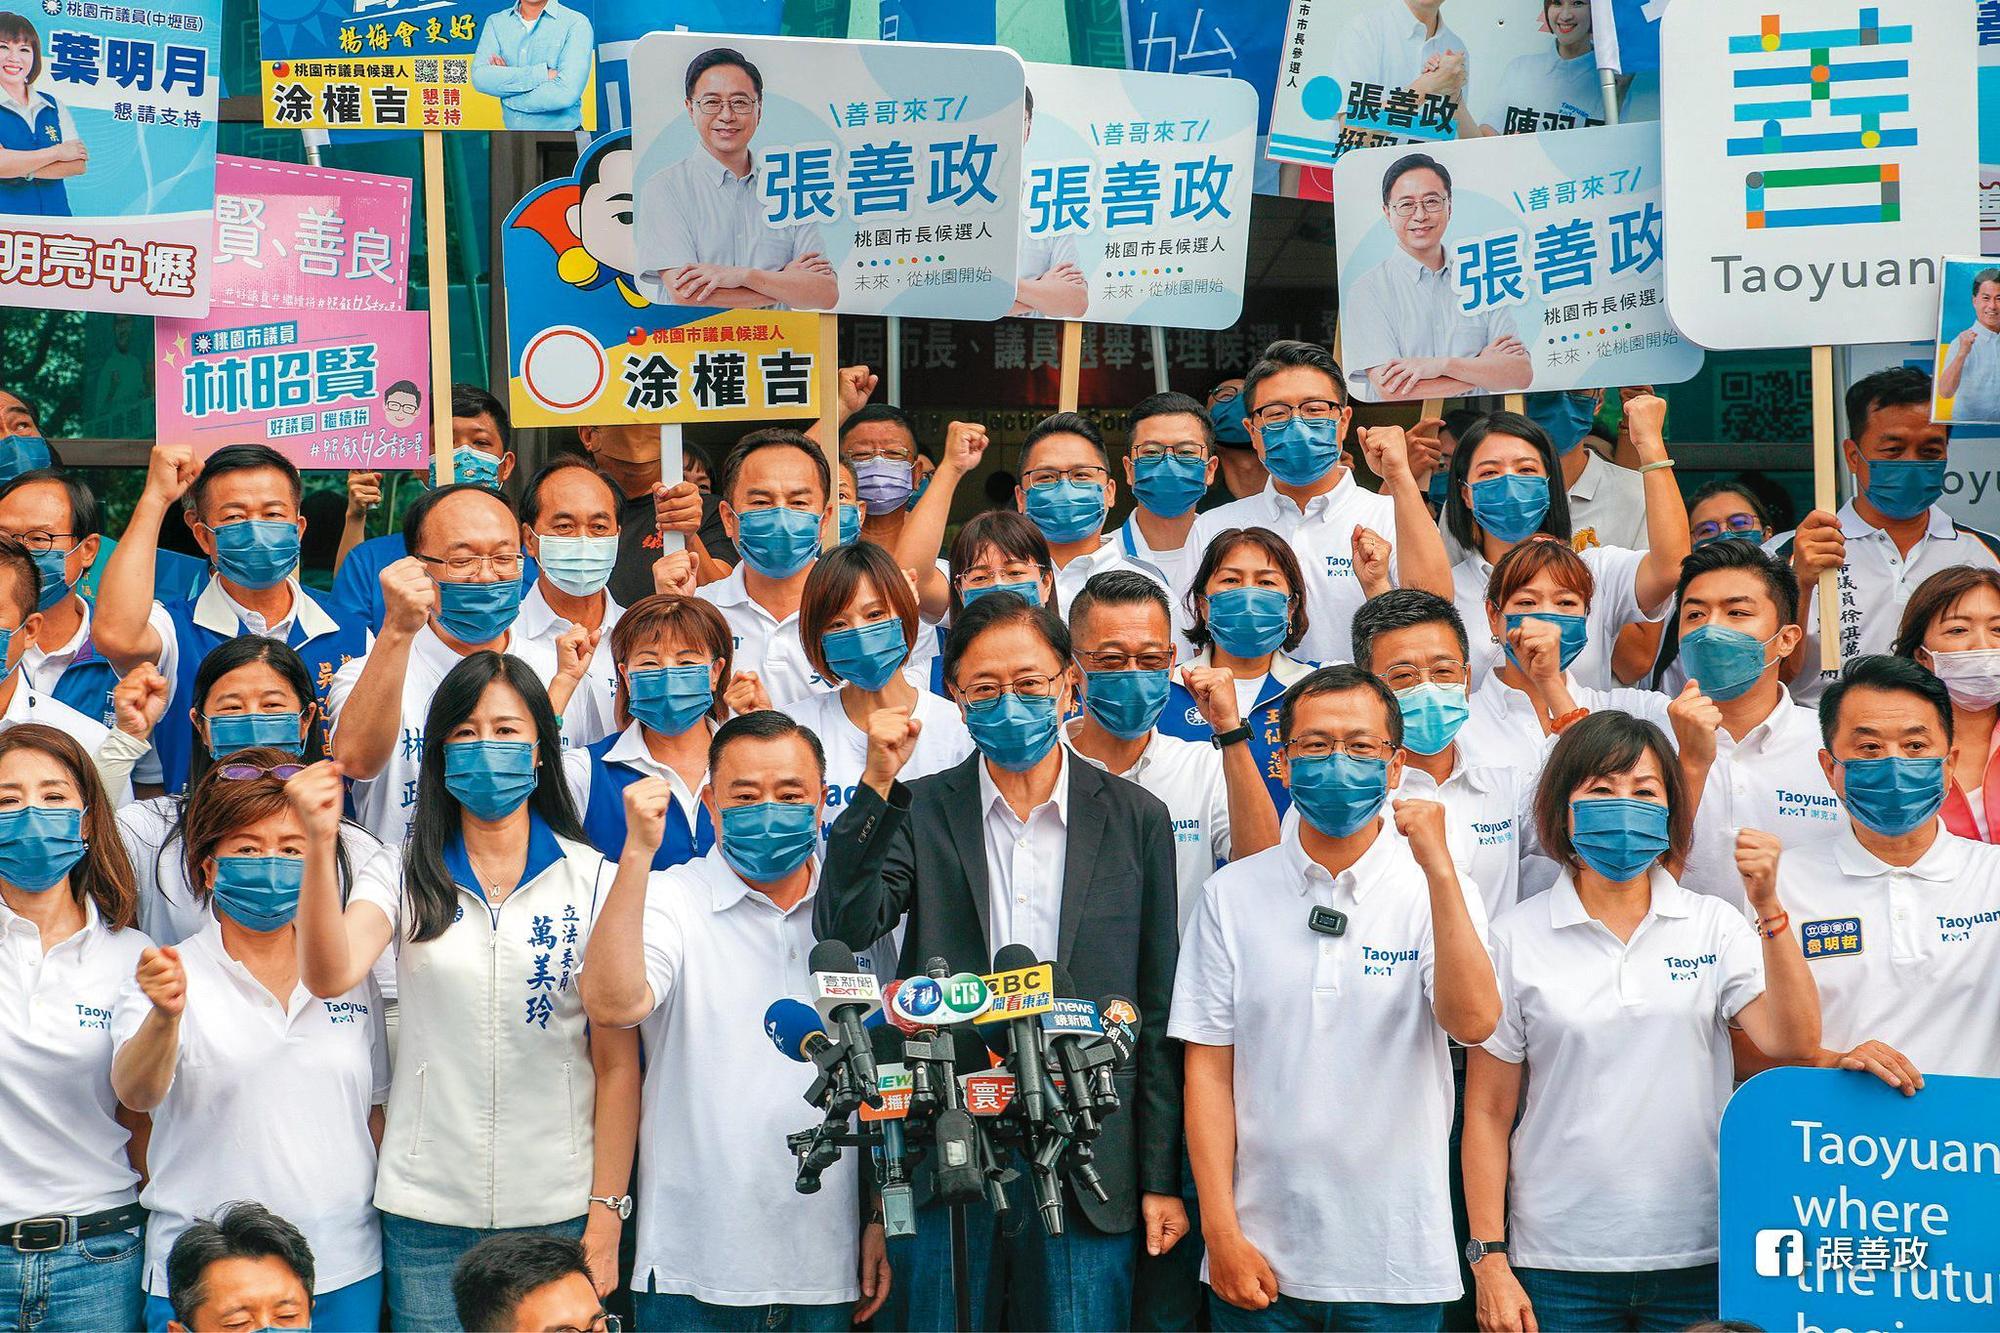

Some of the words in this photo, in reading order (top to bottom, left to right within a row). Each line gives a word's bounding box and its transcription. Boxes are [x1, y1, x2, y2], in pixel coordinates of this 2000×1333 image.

[67, 1, 204, 32] 桃園市議員(中壢區)
[338, 14, 477, 55] 楊梅會更好
[50, 31, 207, 97] 葉明月
[1287, 0, 1312, 88] 市市長參選人
[294, 62, 409, 79] 桃園市議員候選人
[114, 102, 202, 128] 懇請支持
[274, 84, 410, 124] 涂權吉
[422, 88, 461, 107] 懇請
[422, 107, 461, 126] 支持
[1346, 81, 1459, 134] 張善政
[765, 134, 998, 223] 張善政
[1030, 155, 1234, 234] 張善政
[854, 221, 993, 248] 桃園市長候選人
[1105, 236, 1225, 259] 桃園市長候選人
[0, 231, 196, 297] 明亮中壢
[1456, 202, 1664, 312] 張善政
[1711, 255, 1936, 302] Taoyuan
[213, 324, 296, 351] 桃園市議員
[652, 325, 785, 344] 桃園市議員候選人
[184, 344, 379, 416] 林昭賢
[622, 348, 814, 409] 涂權吉
[269, 415, 315, 436] 好議員
[1776, 790, 1838, 807] Taoyuan
[558, 904, 580, 992] 立法委員
[525, 915, 558, 1030] 萬美玲
[951, 981, 980, 1006] CTS
[1790, 1120, 2000, 1180] Taoyuan
[1793, 1184, 1949, 1235] where
